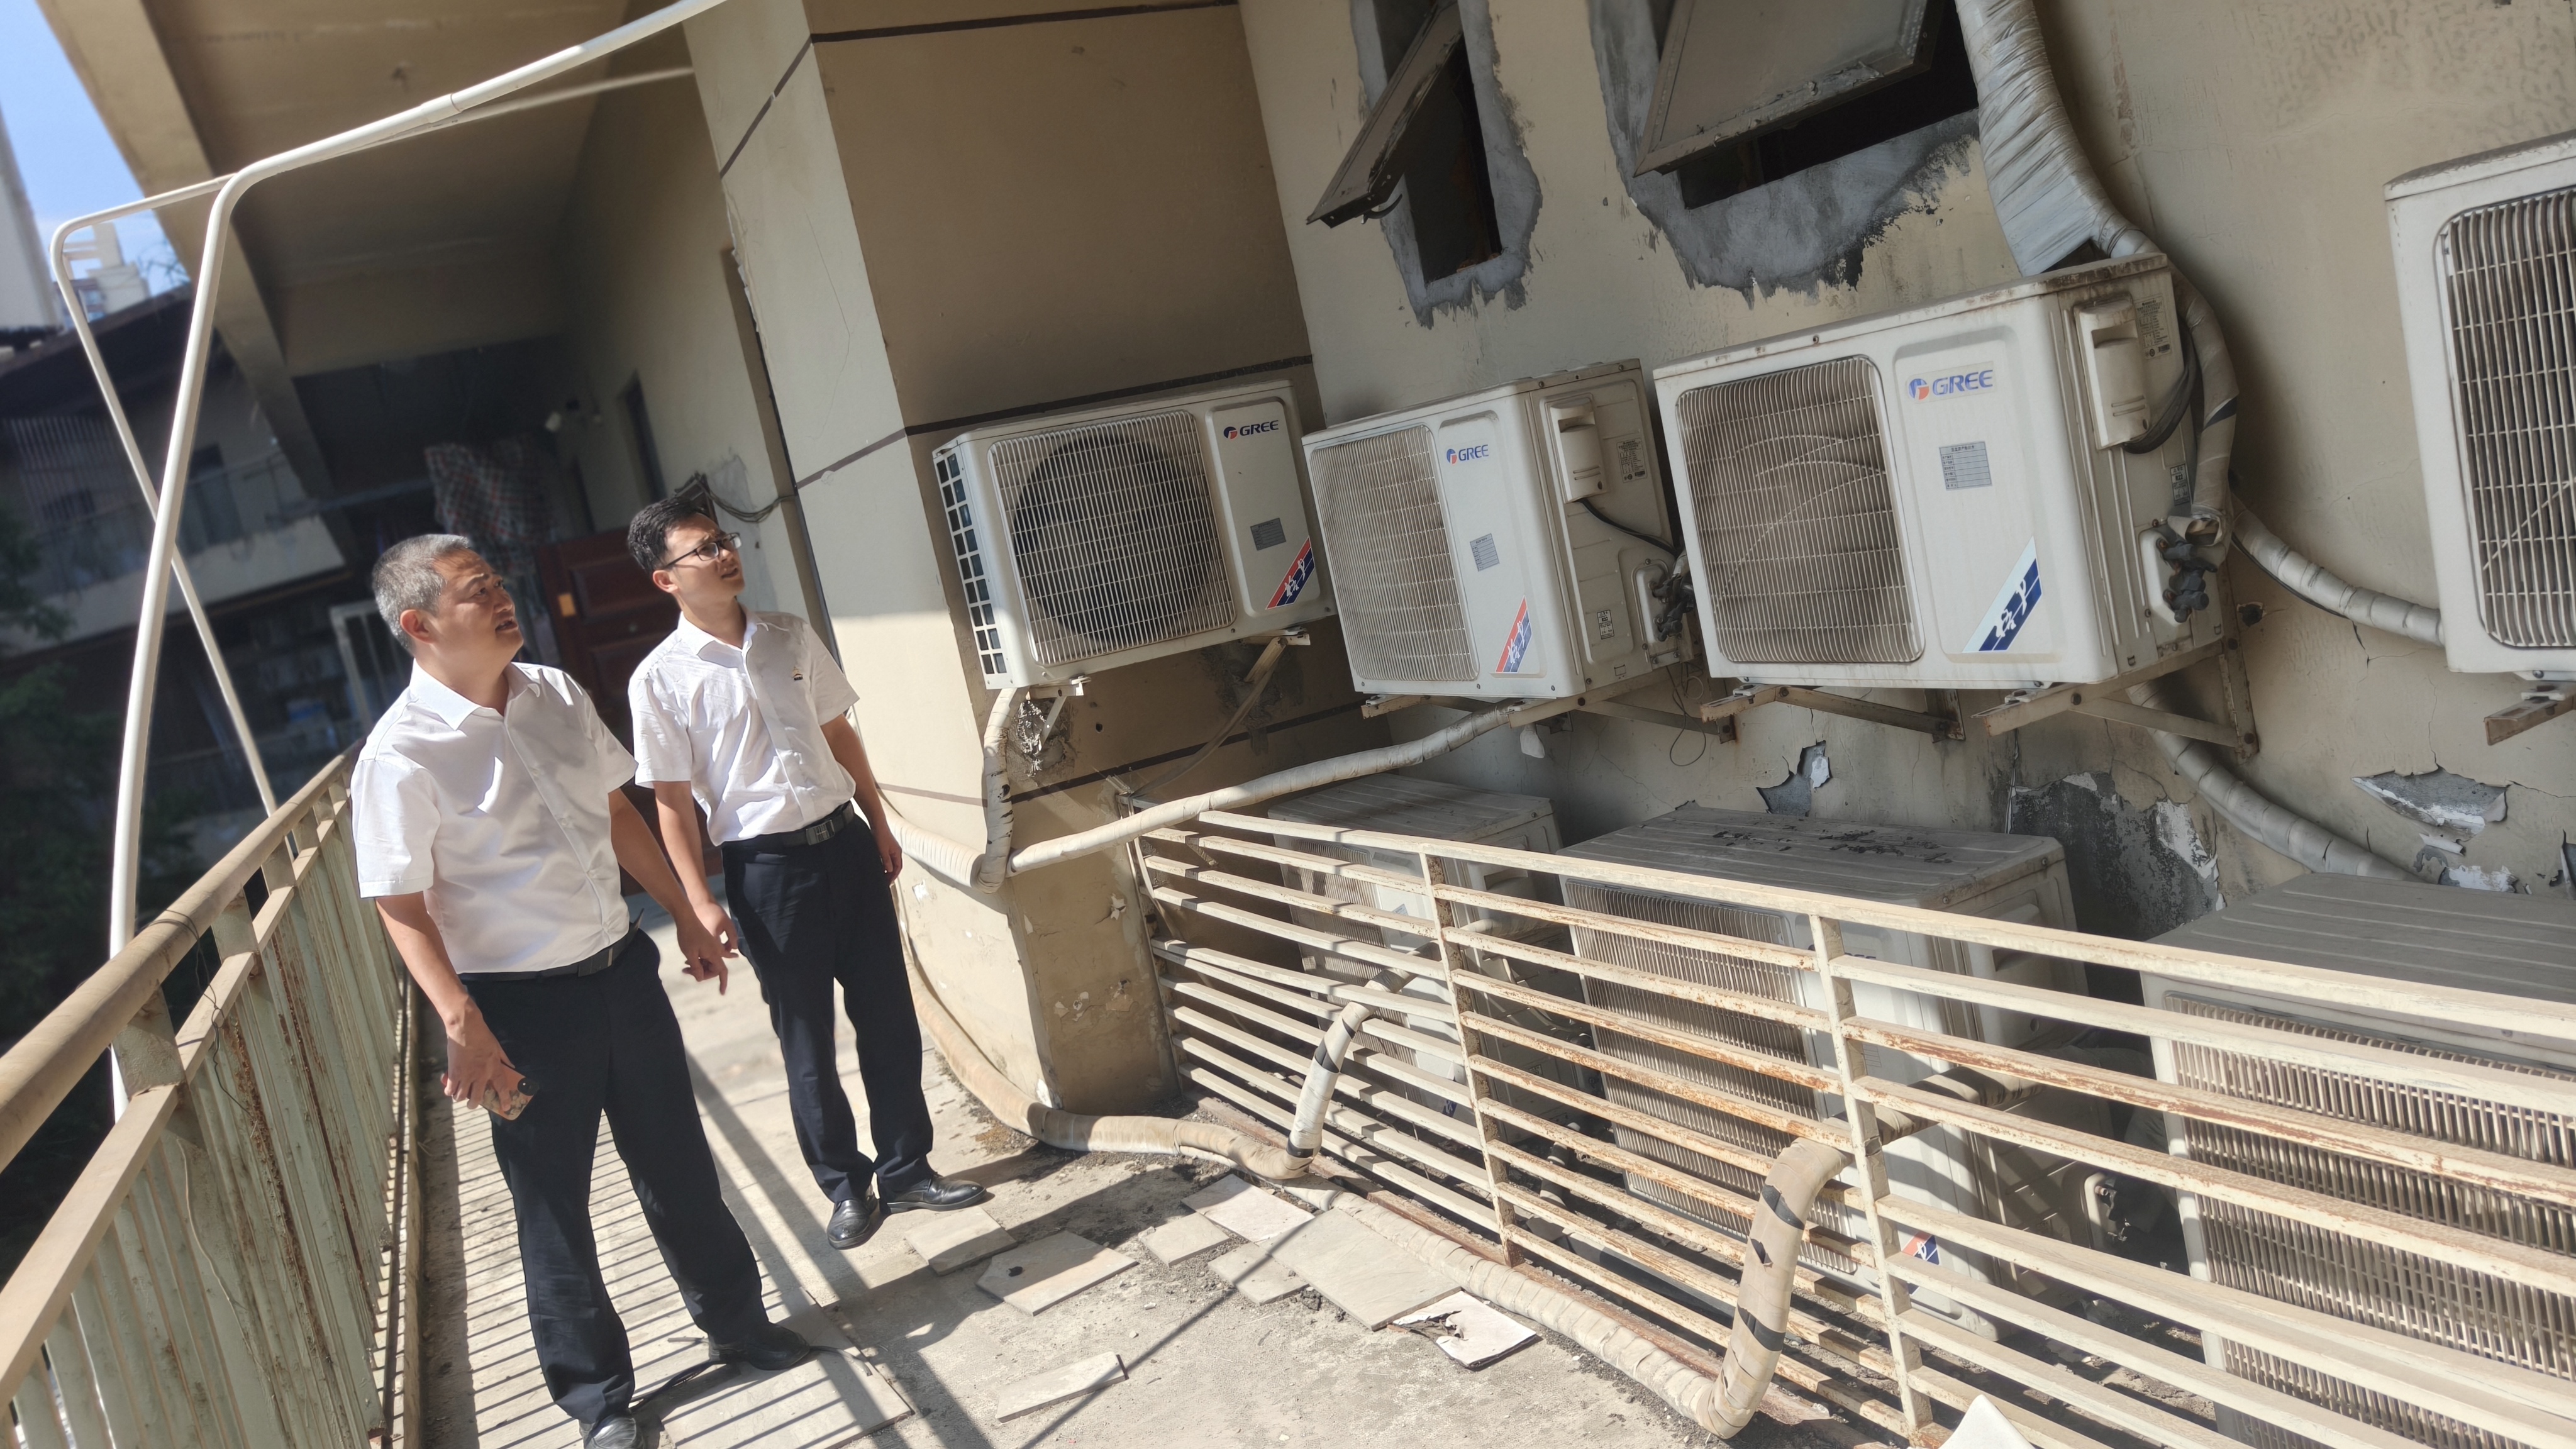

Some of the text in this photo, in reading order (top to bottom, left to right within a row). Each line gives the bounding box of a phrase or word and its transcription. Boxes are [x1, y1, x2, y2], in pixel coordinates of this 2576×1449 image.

[1933, 369, 1993, 396] GREE
[1240, 419, 1279, 436] GREE
[1458, 444, 1489, 461] GREE
